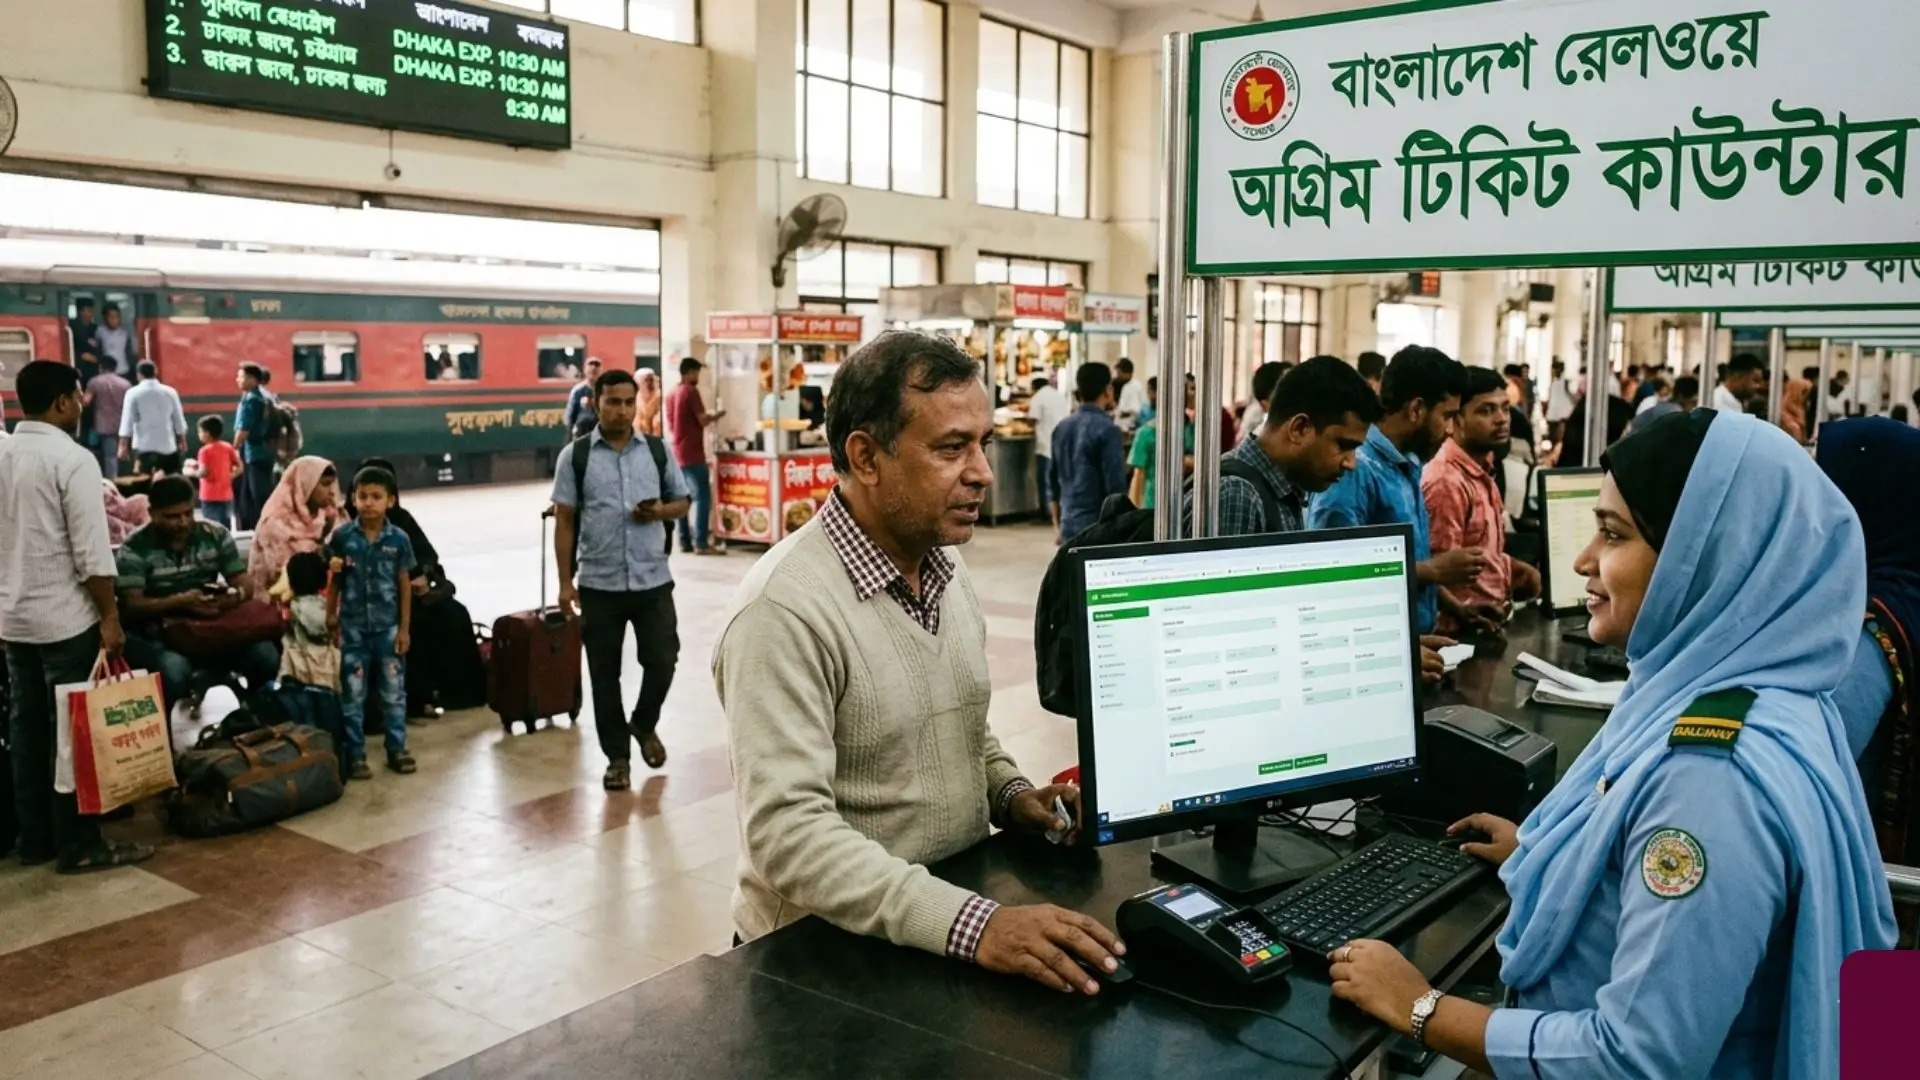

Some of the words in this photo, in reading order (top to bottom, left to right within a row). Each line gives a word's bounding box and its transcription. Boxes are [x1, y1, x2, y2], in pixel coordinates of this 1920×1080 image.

[166, 14, 186, 36] 2.
[167, 42, 186, 64] 3.
[393, 29, 455, 57] DHAKA
[458, 41, 494, 65] EXP.
[498, 50, 539, 72] 10:30
[541, 58, 565, 78] AM
[1329, 33, 1537, 108] বাংলাদেশ
[1556, 11, 1769, 86] রেলওয়ে
[393, 54, 456, 82] DHAKA
[459, 66, 495, 90] EXP.
[498, 74, 539, 96] 10:30
[541, 81, 566, 100] AM
[505, 98, 539, 120] 8:30
[541, 105, 566, 124] AM
[1229, 139, 1381, 228] অগ্রিম
[1395, 121, 1580, 222] টিকিট
[1597, 99, 1920, 211] কাউন্টার
